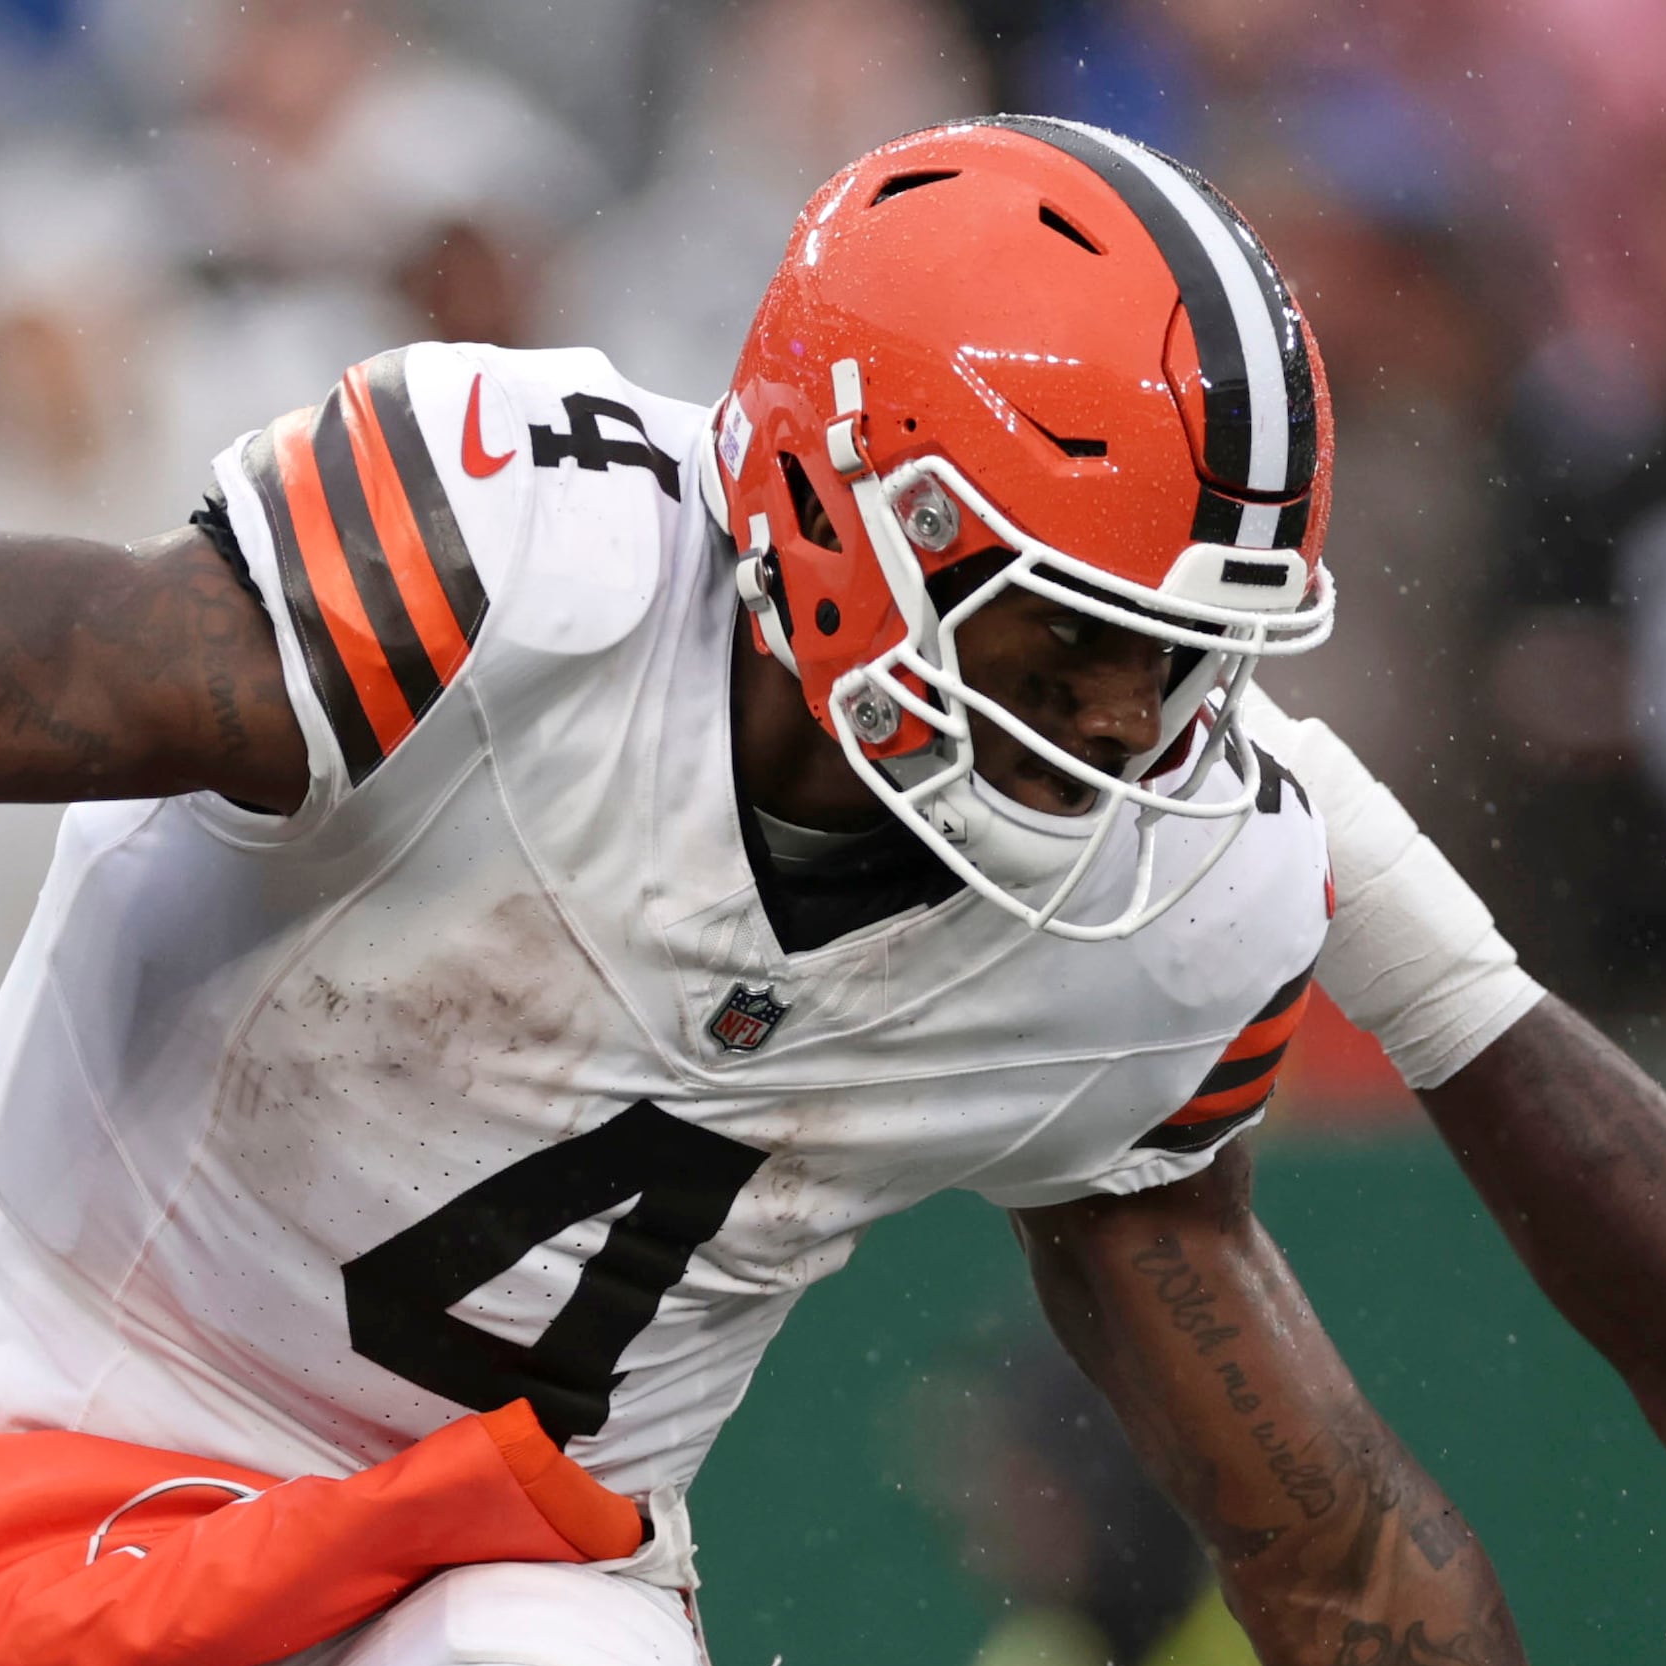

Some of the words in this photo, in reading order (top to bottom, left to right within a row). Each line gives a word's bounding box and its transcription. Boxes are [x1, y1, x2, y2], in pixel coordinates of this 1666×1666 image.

[528, 391, 681, 503] 4
[715, 1009, 765, 1047] NFL
[340, 1099, 772, 1453] 4
